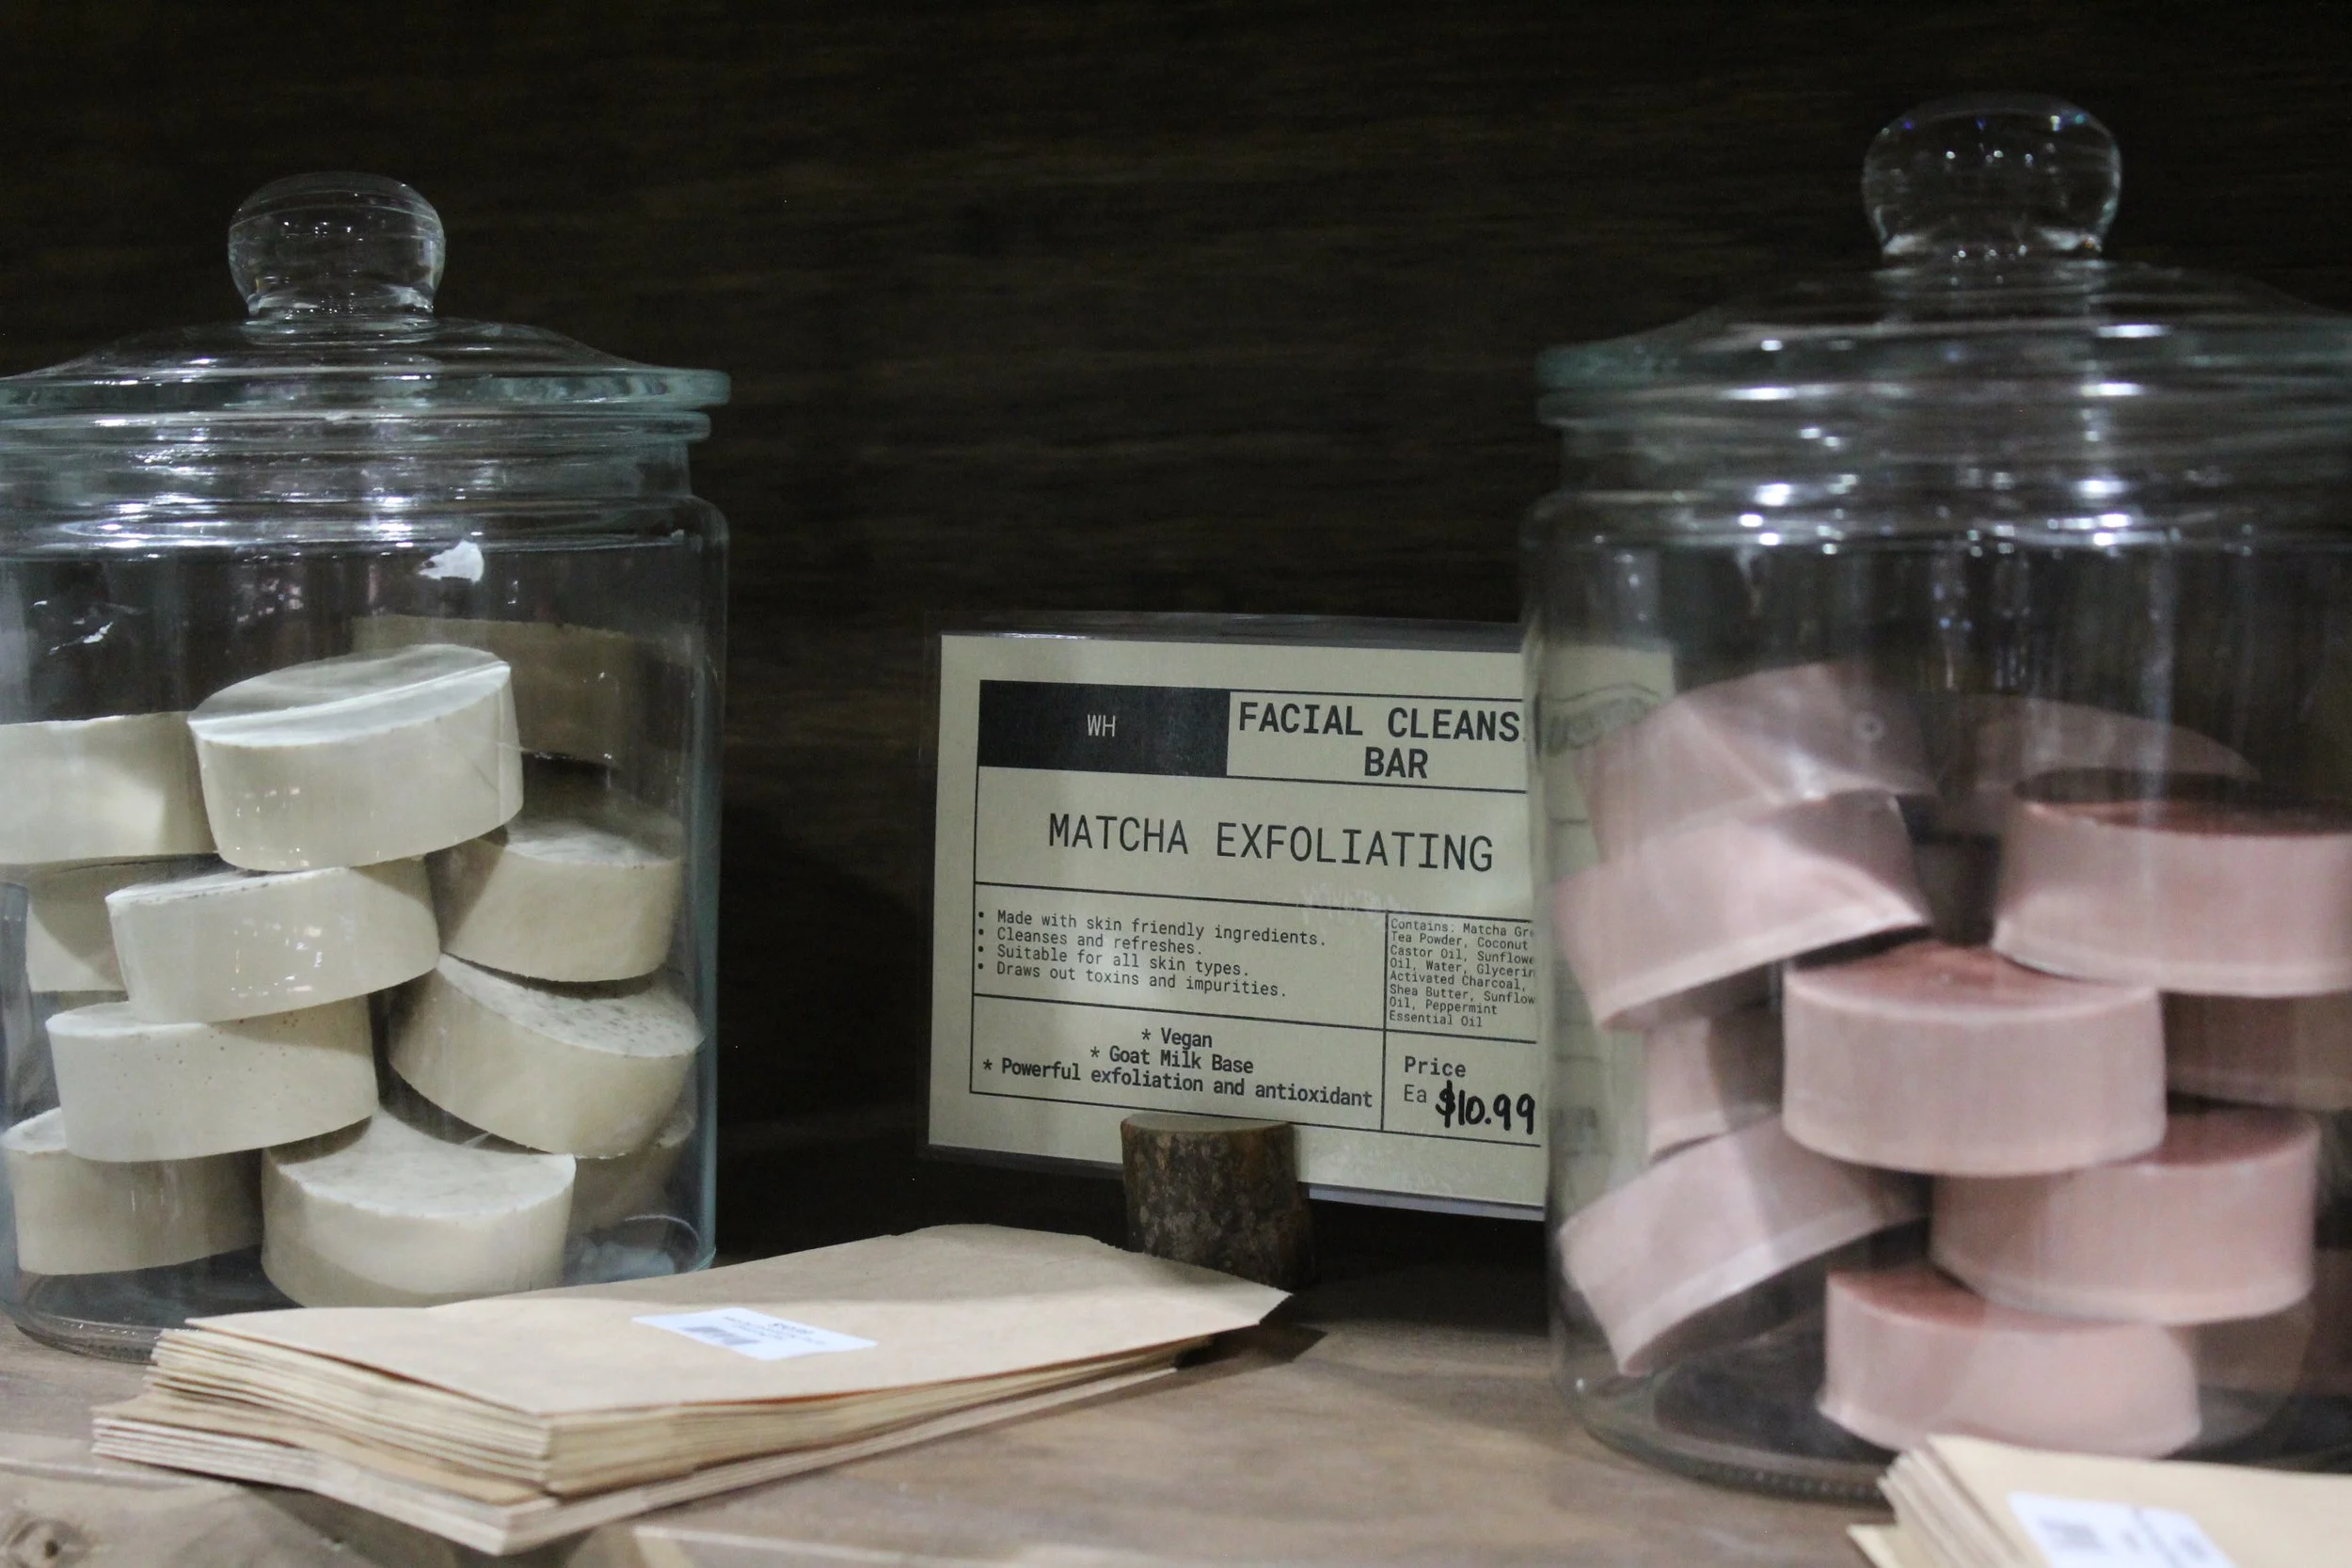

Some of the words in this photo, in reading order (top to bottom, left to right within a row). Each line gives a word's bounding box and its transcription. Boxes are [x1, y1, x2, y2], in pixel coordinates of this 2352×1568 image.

[1088, 714, 1116, 737] WH
[1238, 701, 1363, 736] FACIAL
[1388, 706, 1526, 742] CLEANS
[1364, 746, 1429, 779] BAR
[1048, 812, 1189, 855] MATCHA
[1216, 821, 1494, 873] EXFOLIATING
[997, 910, 1032, 925] Made
[1041, 913, 1077, 928] with
[1087, 916, 1121, 931] skin
[1132, 918, 1204, 939] friendly
[1215, 925, 1326, 946] ingredients.
[1391, 917, 1454, 933] Contains:
[1463, 922, 1507, 936] Matcha
[997, 927, 1068, 944] Cleanses
[1077, 934, 1104, 947] and
[1114, 936, 1202, 955] refreshes.
[1391, 930, 1412, 942] Tea
[1420, 933, 1468, 948] Powder,
[1477, 937, 1528, 950] Coconut
[997, 943, 1068, 962] Suitable
[1077, 949, 1103, 964] for
[1113, 953, 1139, 968] all
[1150, 956, 1185, 971] skin
[1196, 958, 1248, 976] types.
[1391, 945, 1433, 958] Castor
[1440, 949, 1468, 961] Oil,
[1391, 958, 1416, 971] Oil,
[1426, 960, 1468, 974] Water,
[997, 961, 1041, 978] Draws
[1050, 967, 1075, 980] out
[1086, 969, 1139, 985] toxins
[1149, 974, 1176, 988] and
[1186, 976, 1286, 997] impurities.
[1391, 971, 1454, 985] Activated
[1461, 975, 1526, 991] Charcoal,
[1390, 984, 1418, 996] Shea
[1425, 987, 1473, 1002] Butter,
[1390, 997, 1416, 1010] Oil,
[1425, 1000, 1498, 1015] Peppermint
[1390, 1010, 1453, 1024] Essential
[1461, 1016, 1483, 1027] Oil
[1160, 1027, 1213, 1050] Vegan
[1109, 1045, 1150, 1065] Goat
[1160, 1050, 1201, 1069] Milk
[1212, 1053, 1254, 1074] Base
[1404, 1055, 1467, 1078] Price
[1002, 1057, 1081, 1081] Powerful
[1090, 1067, 1203, 1092] exfoliation
[1214, 1078, 1245, 1096] and
[1255, 1083, 1373, 1108] antioxidant
[1404, 1084, 1427, 1103] Ea
[1435, 1079, 1535, 1135] $10.99
